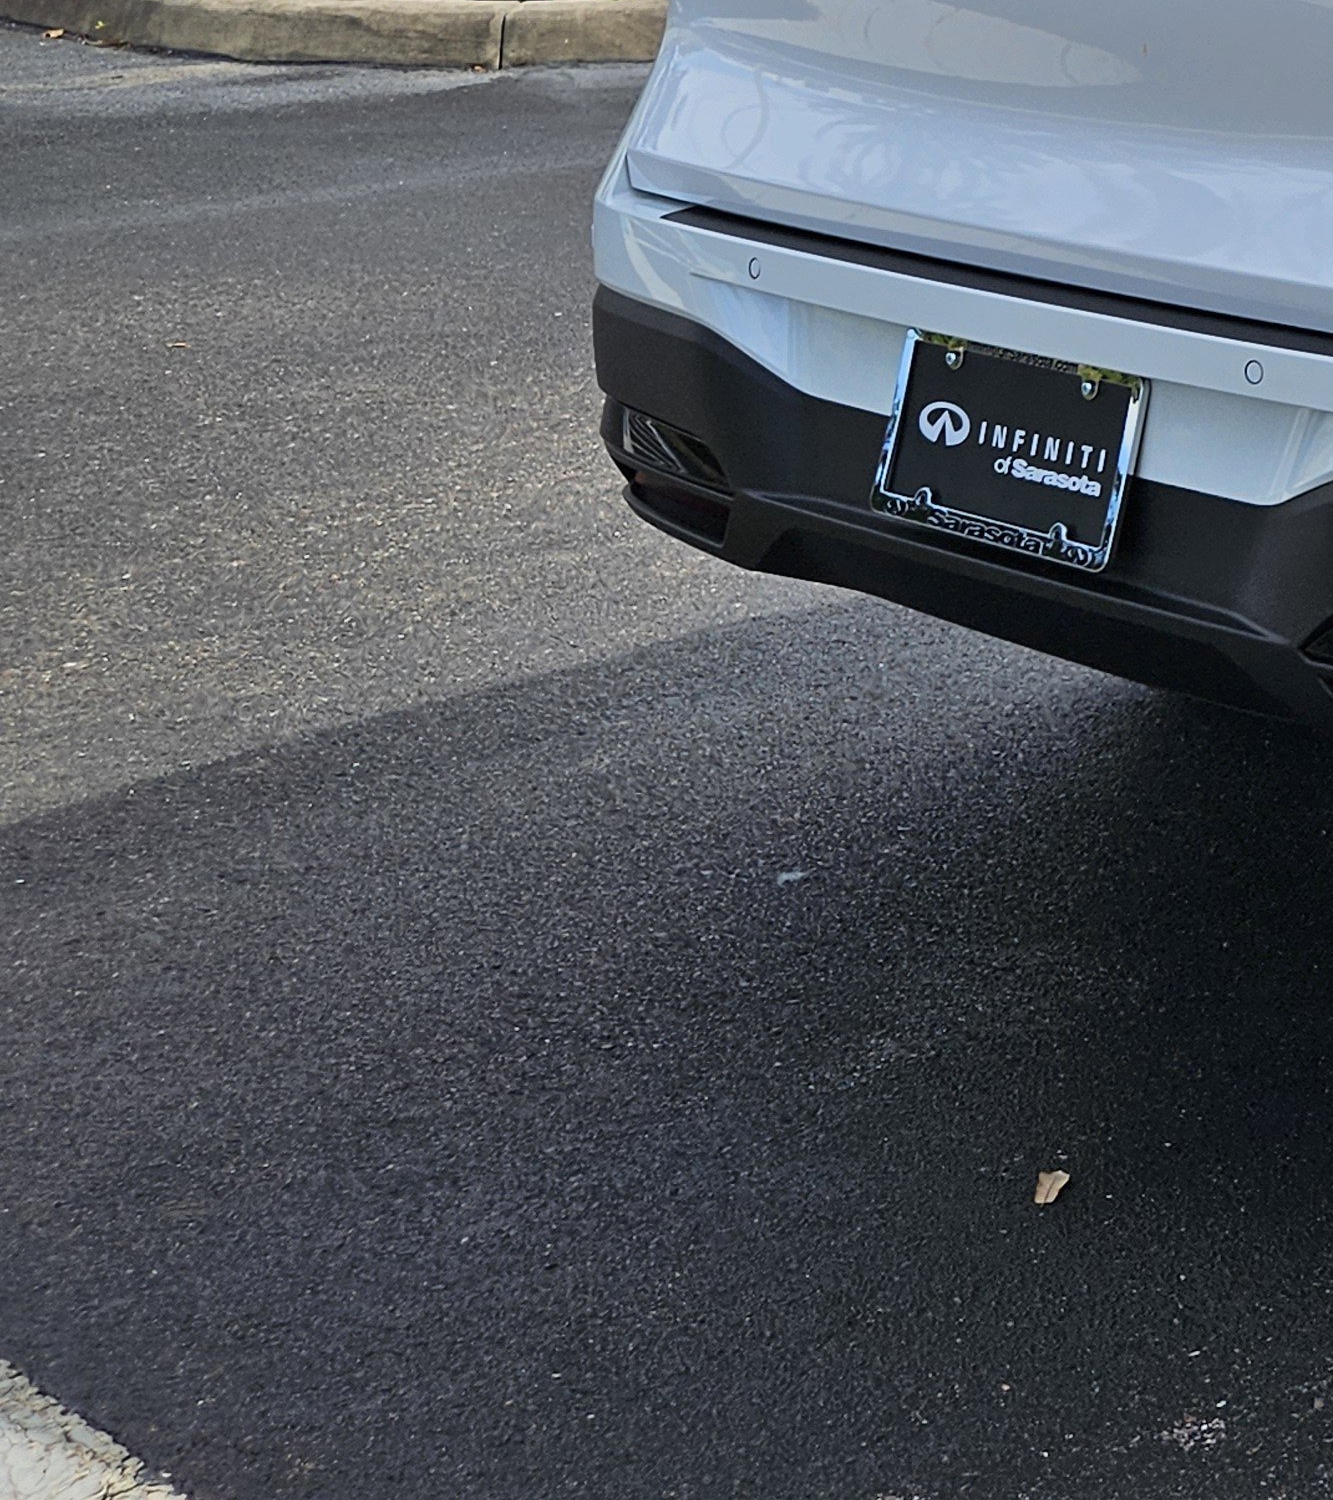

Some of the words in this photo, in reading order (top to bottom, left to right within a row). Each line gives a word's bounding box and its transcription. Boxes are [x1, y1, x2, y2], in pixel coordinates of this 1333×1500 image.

[978, 420, 1107, 473] INFINITI
[993, 456, 1013, 475] of
[1011, 458, 1102, 498] Sarasota
[927, 507, 1042, 555] Sarasota
